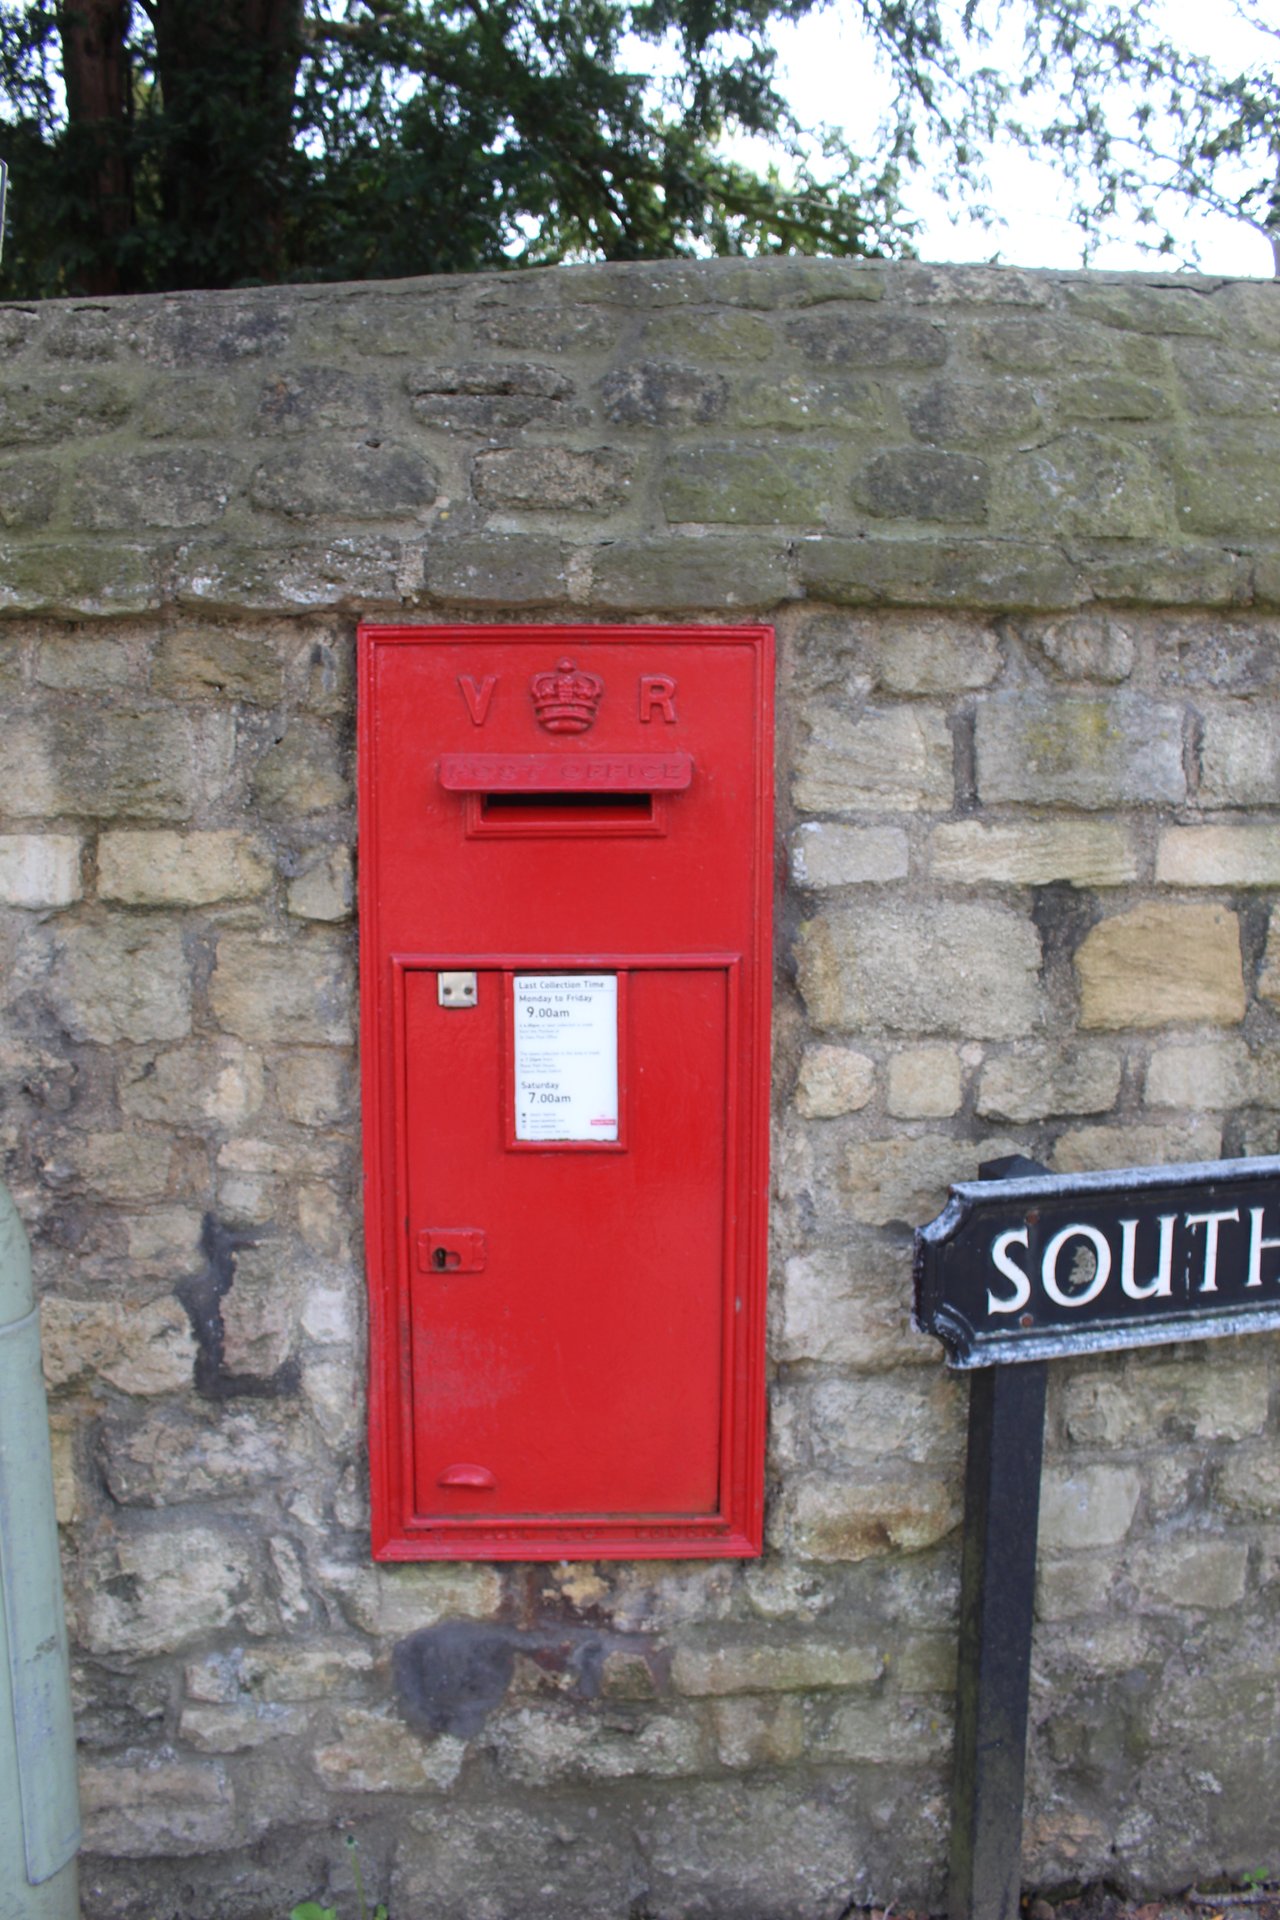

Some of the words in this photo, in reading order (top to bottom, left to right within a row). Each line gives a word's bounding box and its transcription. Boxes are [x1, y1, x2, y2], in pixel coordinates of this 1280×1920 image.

[457, 673, 497, 726] V
[639, 673, 678, 724] R
[447, 762, 543, 783] POST
[560, 762, 682, 783] OFFICE
[518, 980, 537, 989] Last
[540, 980, 581, 989] Collection
[584, 980, 605, 989] Time
[518, 994, 552, 1004] Monday
[555, 994, 563, 1002] to
[566, 993, 592, 1003] Friday
[526, 1006, 570, 1018] 9.00am
[520, 1081, 560, 1090] Saturday
[528, 1091, 572, 1103] 7.00am
